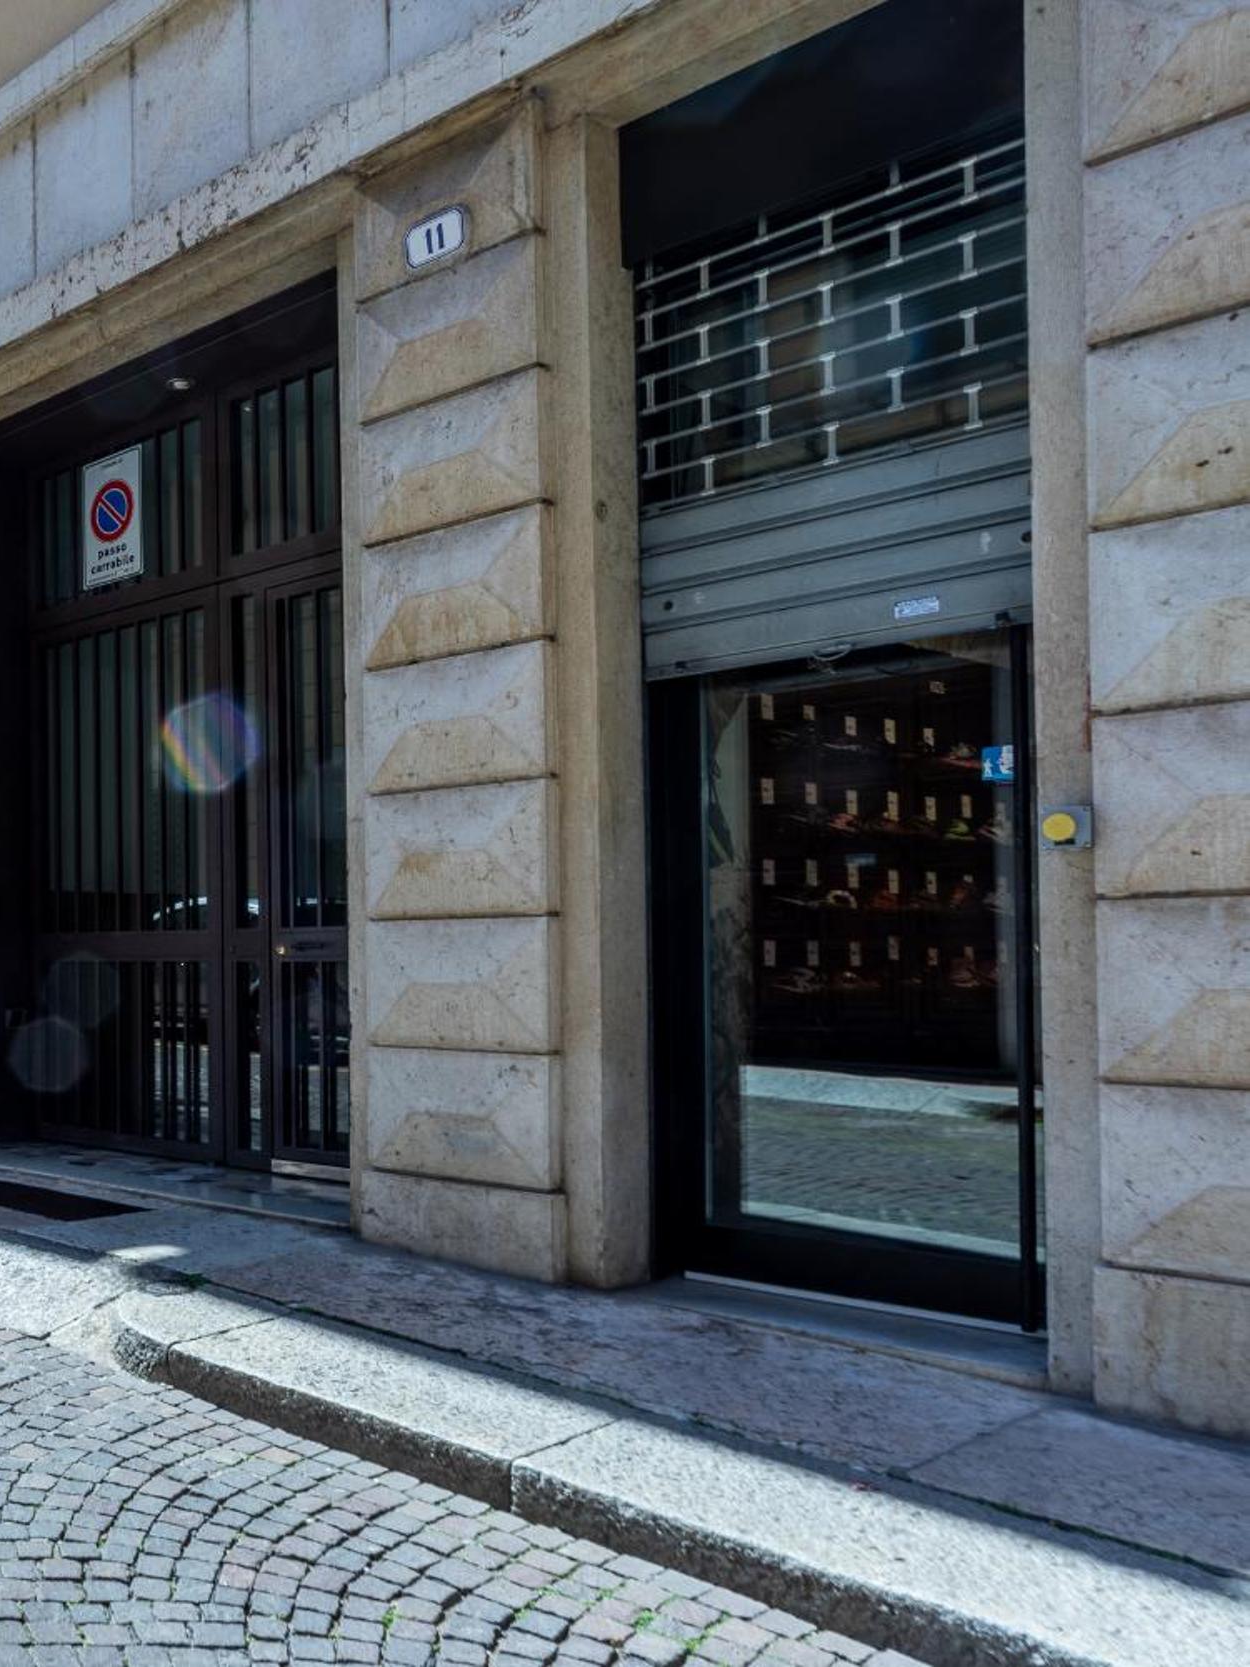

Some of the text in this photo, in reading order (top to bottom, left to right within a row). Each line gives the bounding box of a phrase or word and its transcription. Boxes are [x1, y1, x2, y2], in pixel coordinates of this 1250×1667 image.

[425, 223, 444, 254] 11
[98, 542, 127, 560] passo
[91, 555, 135, 574] carrabile
